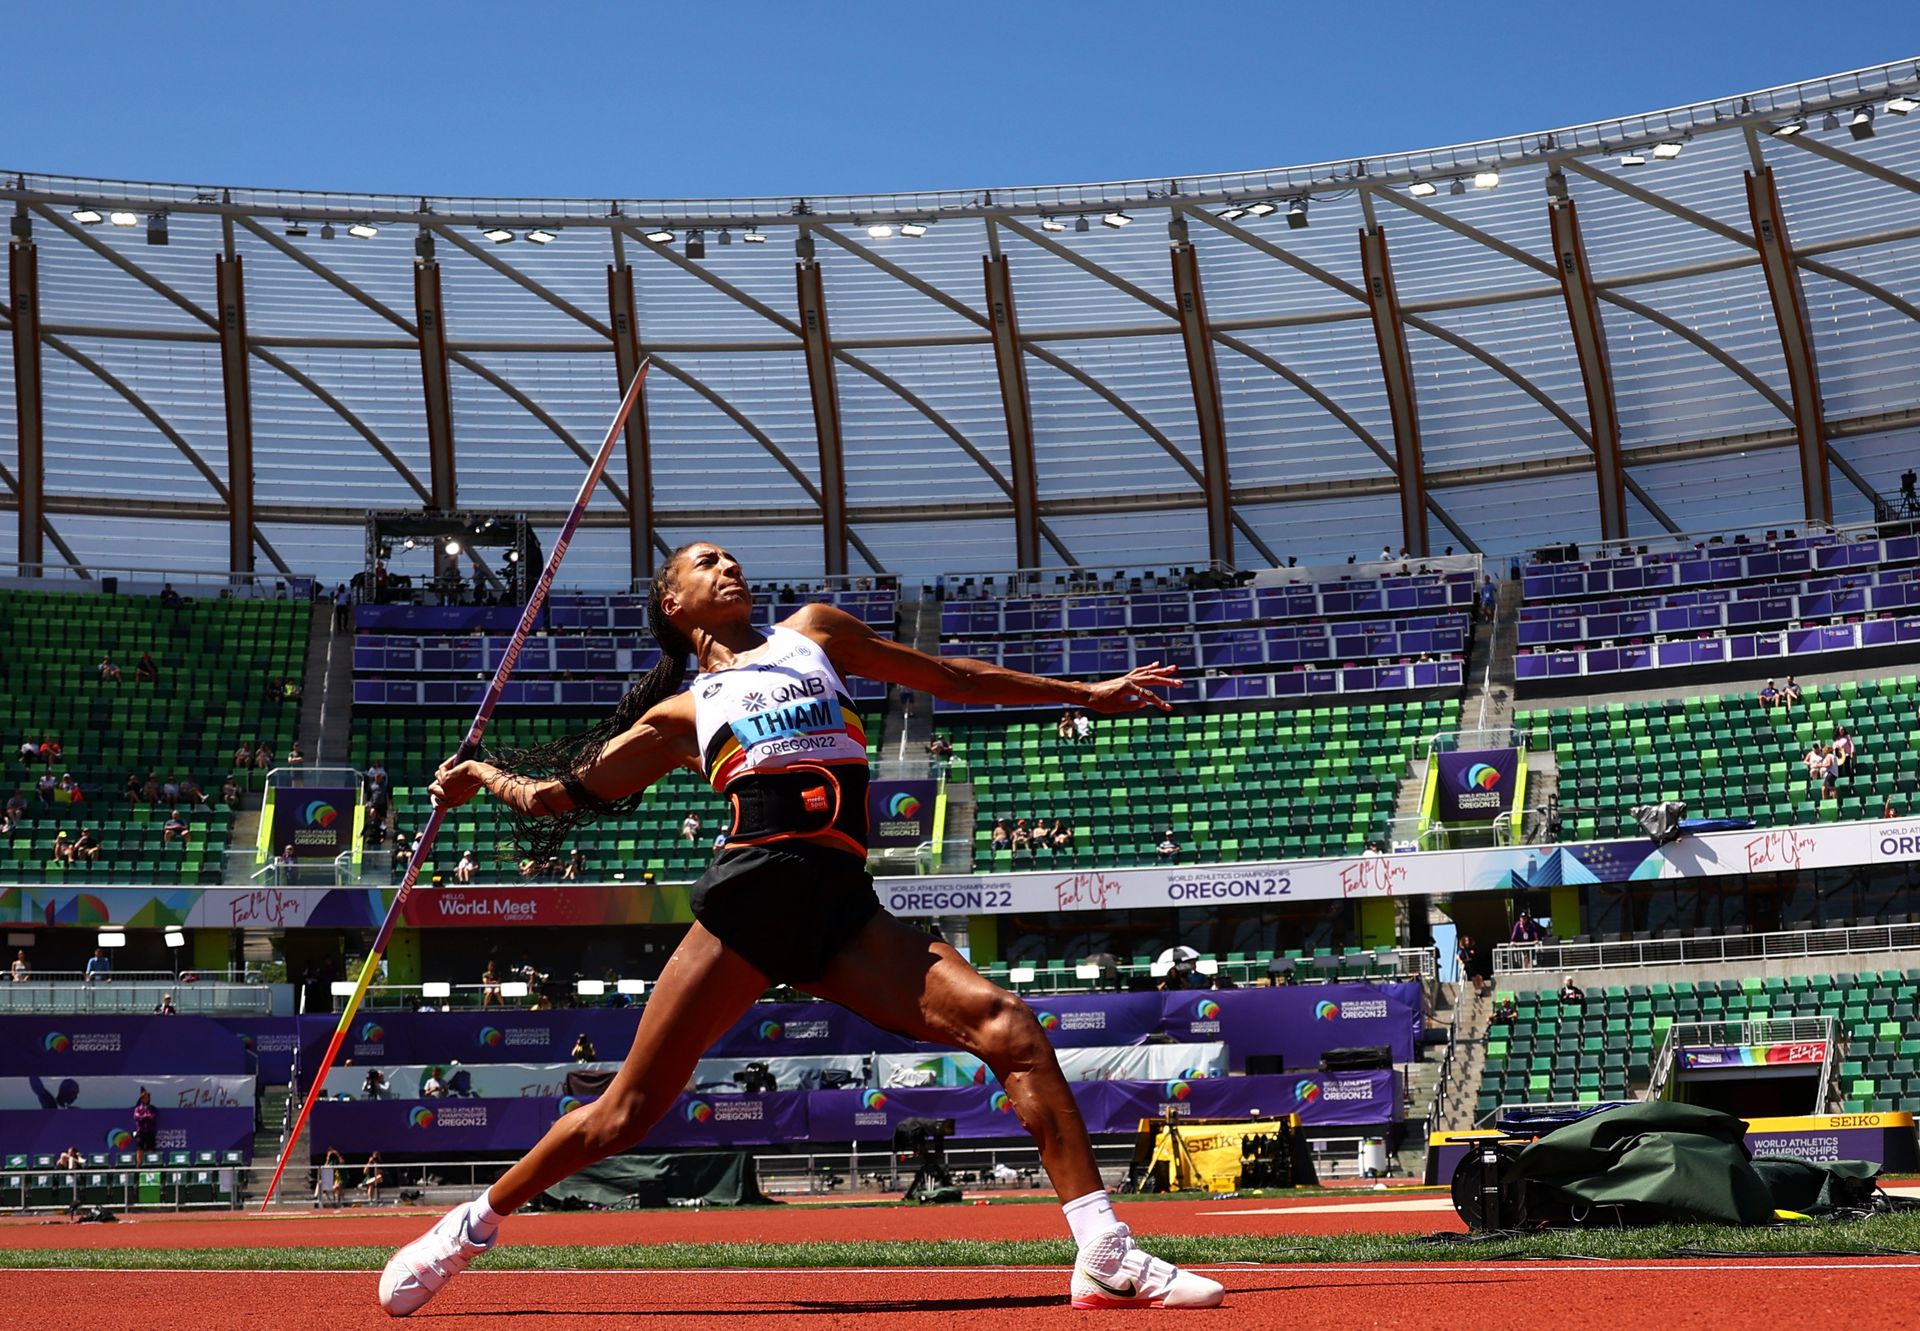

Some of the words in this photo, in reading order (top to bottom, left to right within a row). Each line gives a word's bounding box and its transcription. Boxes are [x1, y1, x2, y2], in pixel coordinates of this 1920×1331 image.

[757, 652, 796, 673] Allianz
[771, 677, 825, 703] QNB
[748, 702, 833, 737] THIAM
[761, 736, 836, 756] OREGON22
[1880, 828, 1908, 837] WORLD
[1168, 875, 1193, 883] WORLD
[1195, 873, 1232, 881] ATHLETICS
[1233, 870, 1291, 880] CHAMPIONSHIPS
[917, 884, 954, 892] ATHLETICS
[955, 882, 1012, 891] CHAMPIONSHIPS
[438, 900, 490, 915] World.
[493, 899, 537, 914] Meet
[1830, 1115, 1880, 1128] SEIKO
[1754, 1139, 1787, 1148] WORLD
[1789, 1137, 1838, 1147] ATHLETICS
[1754, 1146, 1838, 1156] CHAMPIONSHIPS
